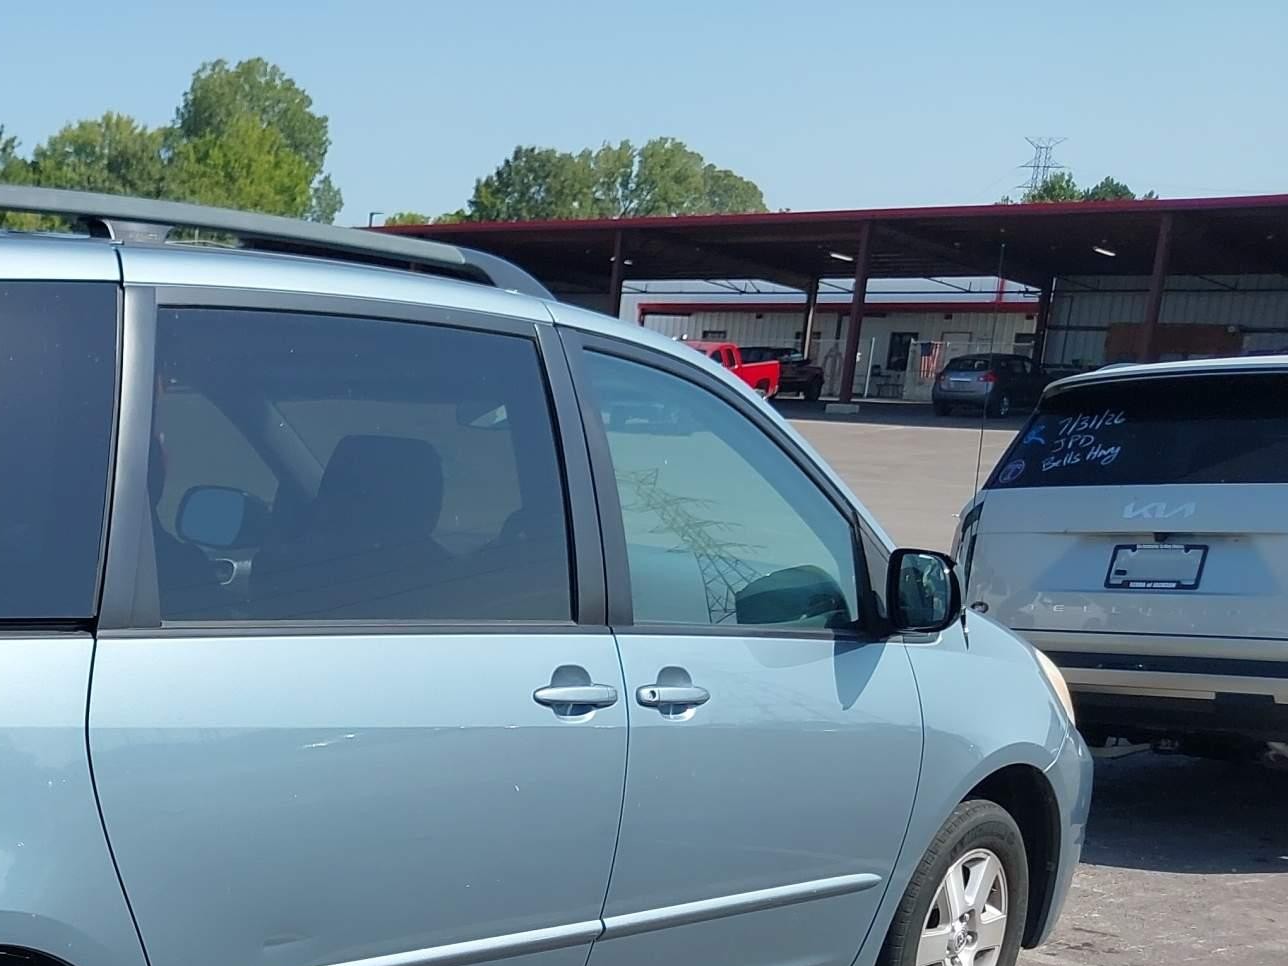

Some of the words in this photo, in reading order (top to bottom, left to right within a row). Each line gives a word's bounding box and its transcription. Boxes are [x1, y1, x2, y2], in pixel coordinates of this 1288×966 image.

[1058, 409, 1126, 436] 7/31/26
[1051, 434, 1095, 453] JPD
[1041, 452, 1081, 472] Bells
[1121, 501, 1197, 519] KIA
